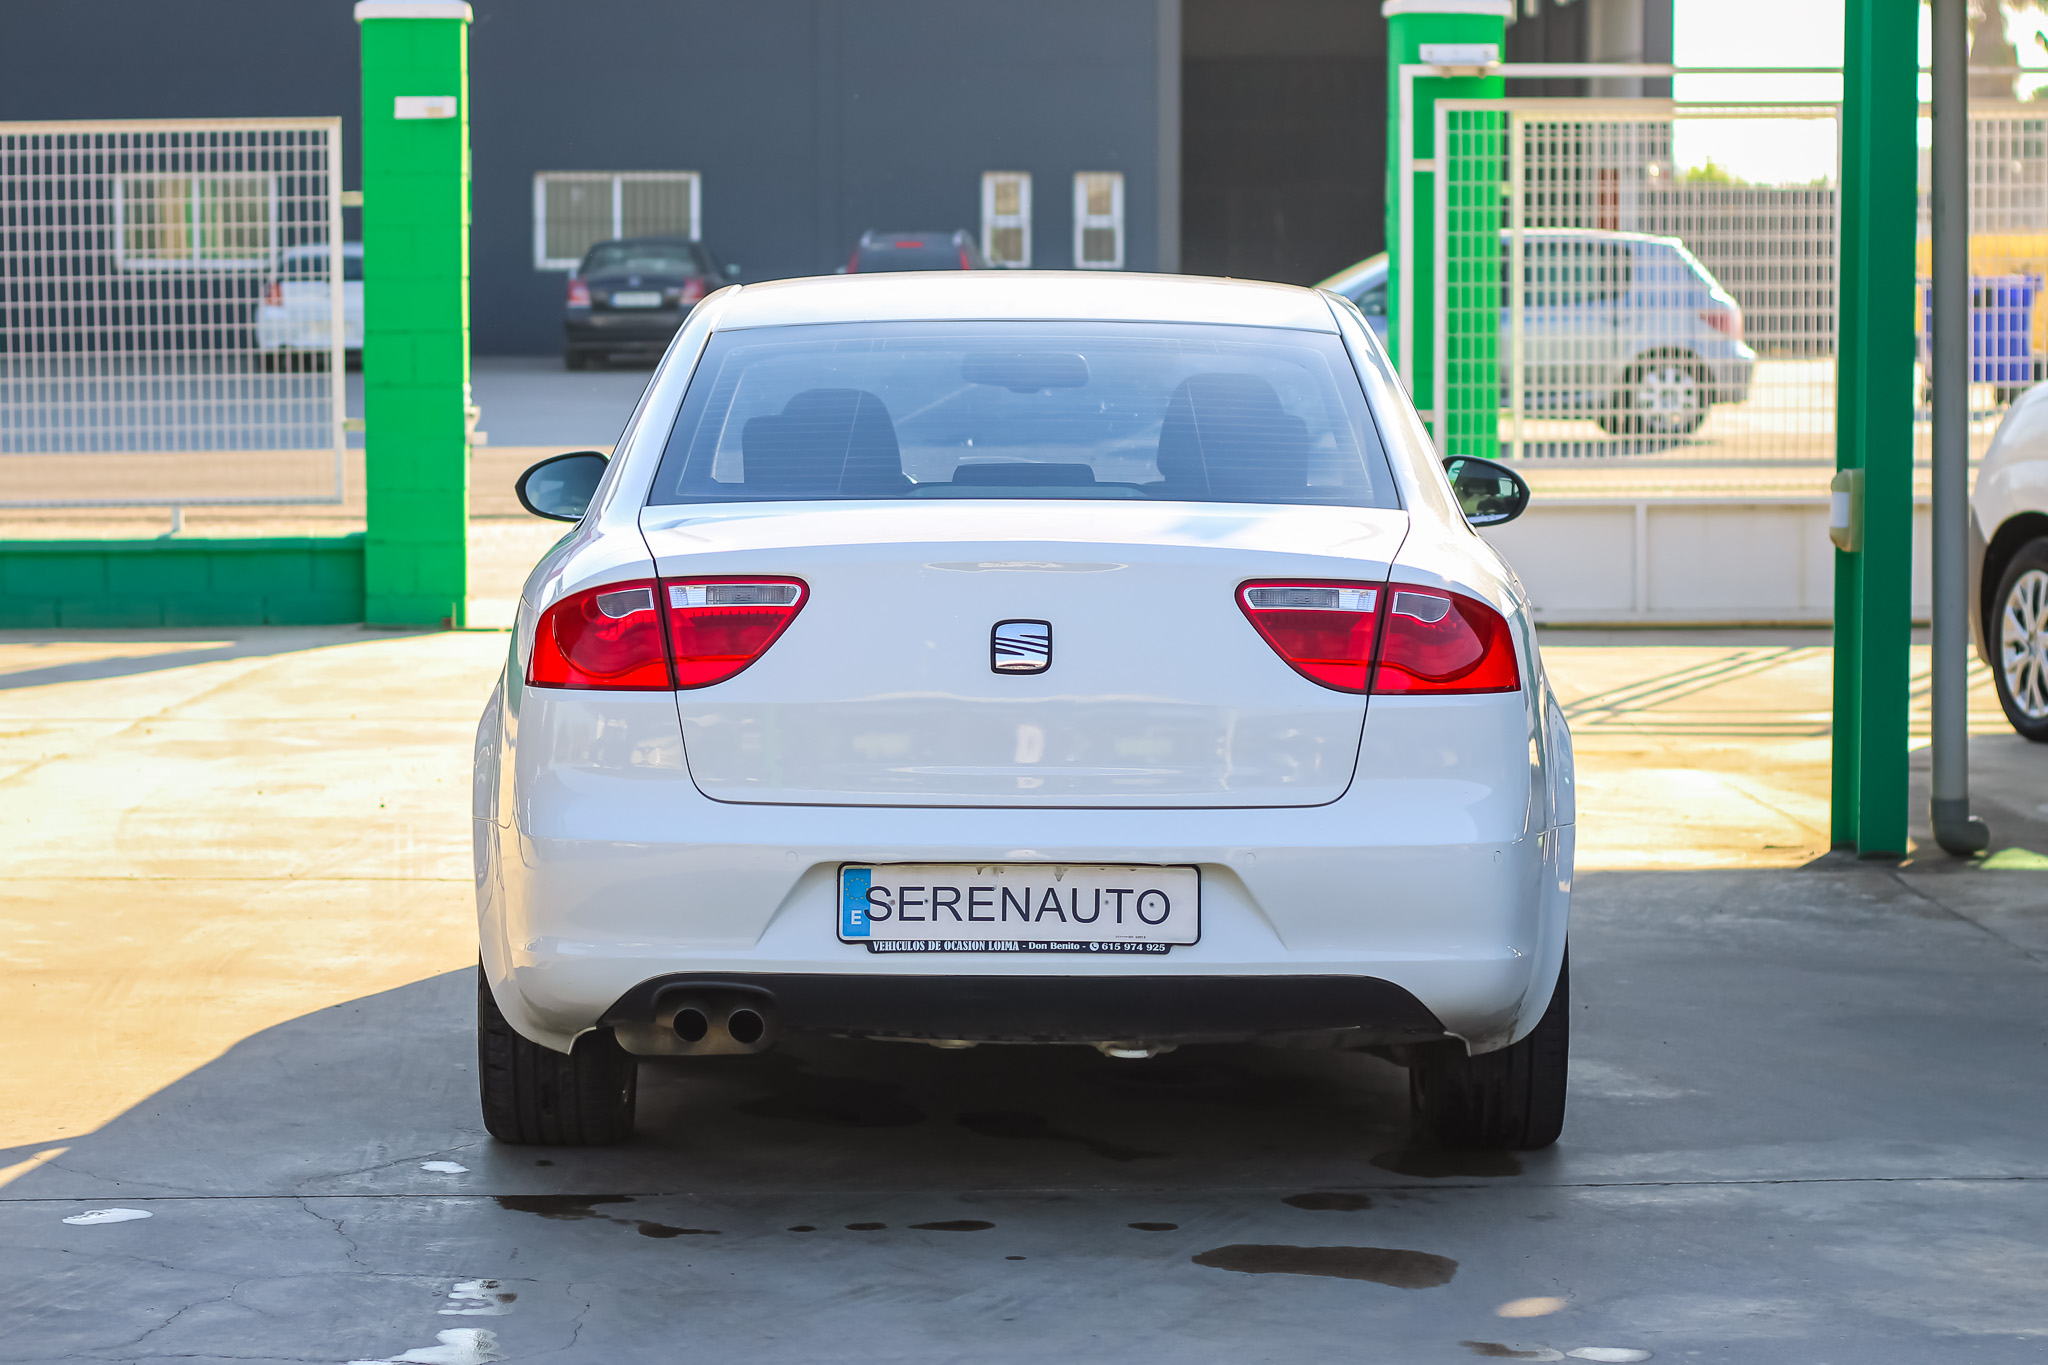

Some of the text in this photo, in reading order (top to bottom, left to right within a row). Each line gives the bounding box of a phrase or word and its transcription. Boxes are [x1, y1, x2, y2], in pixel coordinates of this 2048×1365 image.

[864, 885, 1171, 925] SERENAUTO
[851, 910, 862, 925] E
[873, 941, 925, 951] VEHICULOS
[927, 941, 941, 951] DE
[944, 941, 985, 951] OCASION
[1029, 942, 1048, 950] Don
[1050, 942, 1080, 950] Benito
[1102, 943, 1121, 951] 615
[1124, 943, 1143, 951] 974
[1146, 943, 1166, 951] 925
